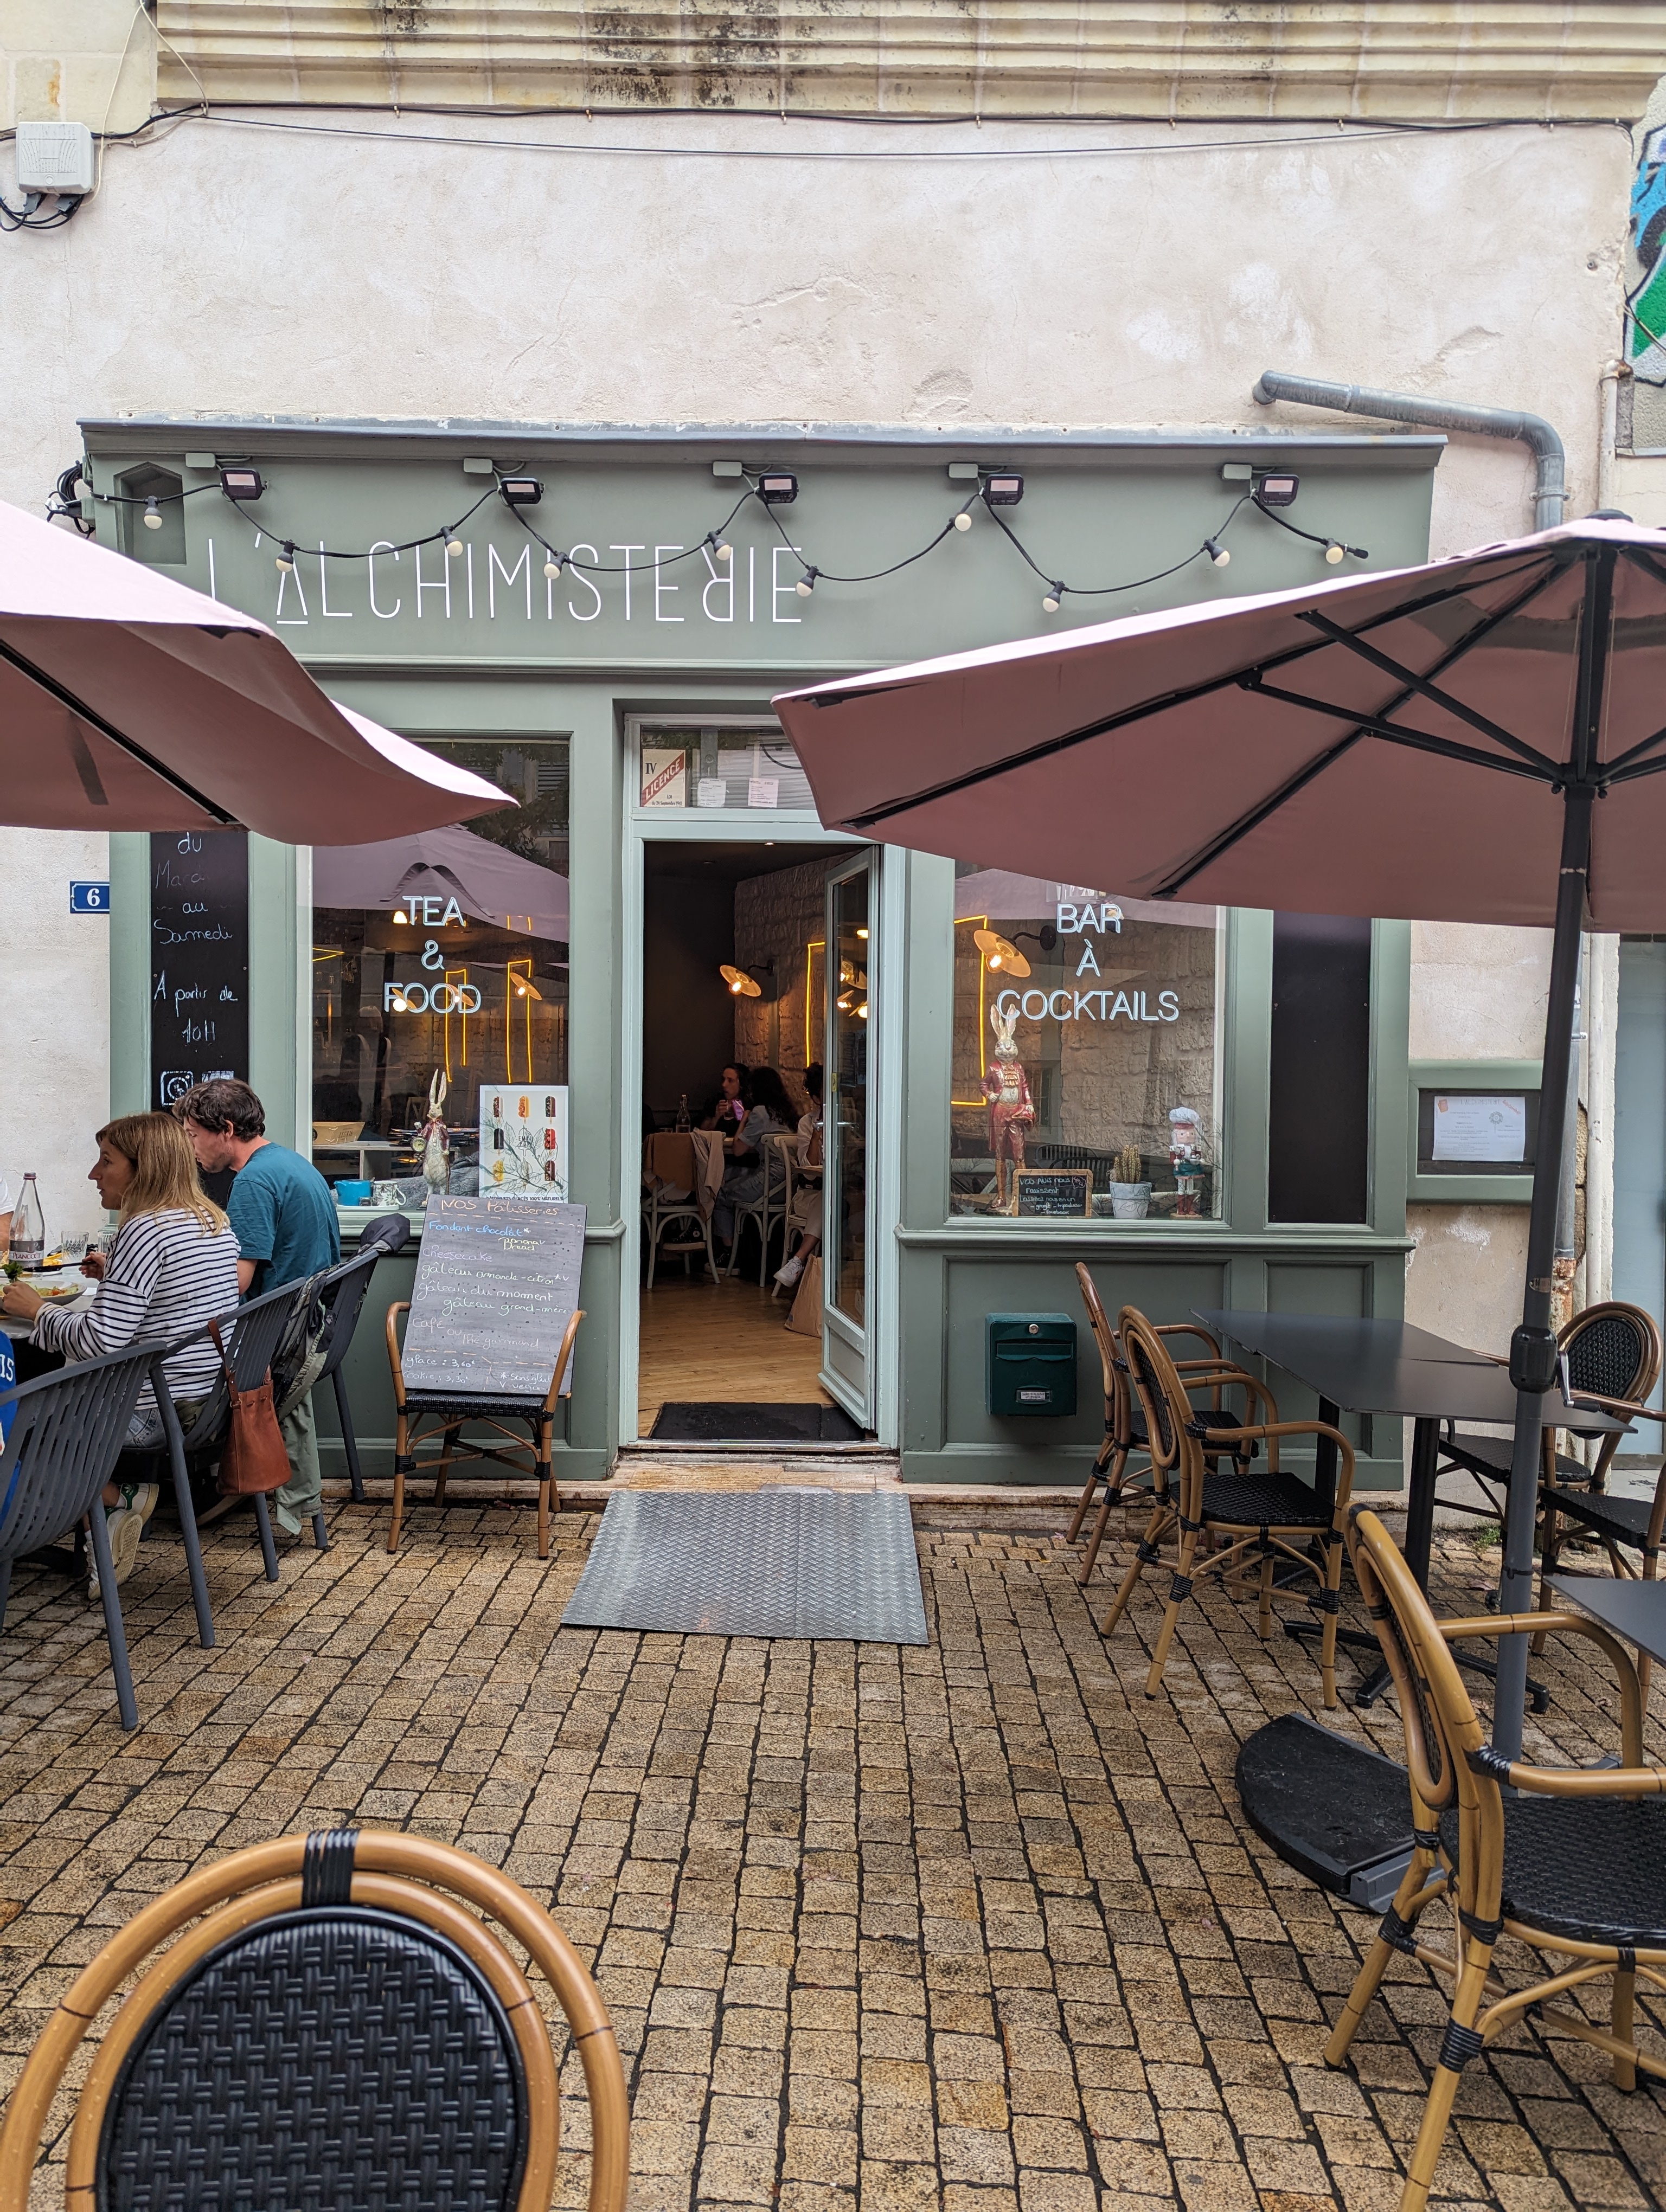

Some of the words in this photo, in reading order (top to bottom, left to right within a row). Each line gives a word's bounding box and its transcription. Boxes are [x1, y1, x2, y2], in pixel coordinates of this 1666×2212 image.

[645, 763, 657, 774] IV
[645, 758, 680, 801] LICENCE
[177, 832, 202, 854] du
[87, 888, 100, 906] 6
[182, 902, 209, 914] au
[402, 896, 466, 926] TEA
[1056, 904, 1122, 934] BAR
[153, 919, 233, 944] Samedi
[421, 940, 445, 970] &
[1075, 938, 1101, 977] À
[175, 982, 208, 1018] partir
[220, 986, 239, 1001] de
[384, 982, 482, 1014] FOOD
[997, 989, 1180, 1021] COCKTAILS
[487, 1199, 560, 1216] Pâtisseries
[428, 1220, 473, 1232] Fondant
[476, 1272, 518, 1281] amande
[470, 1285, 493, 1296] du
[496, 1290, 553, 1302] moment
[441, 1297, 495, 1317] gâteau
[498, 1303, 568, 1316] grand-mère
[412, 1317, 445, 1334] Café
[405, 1354, 438, 1368] glace
